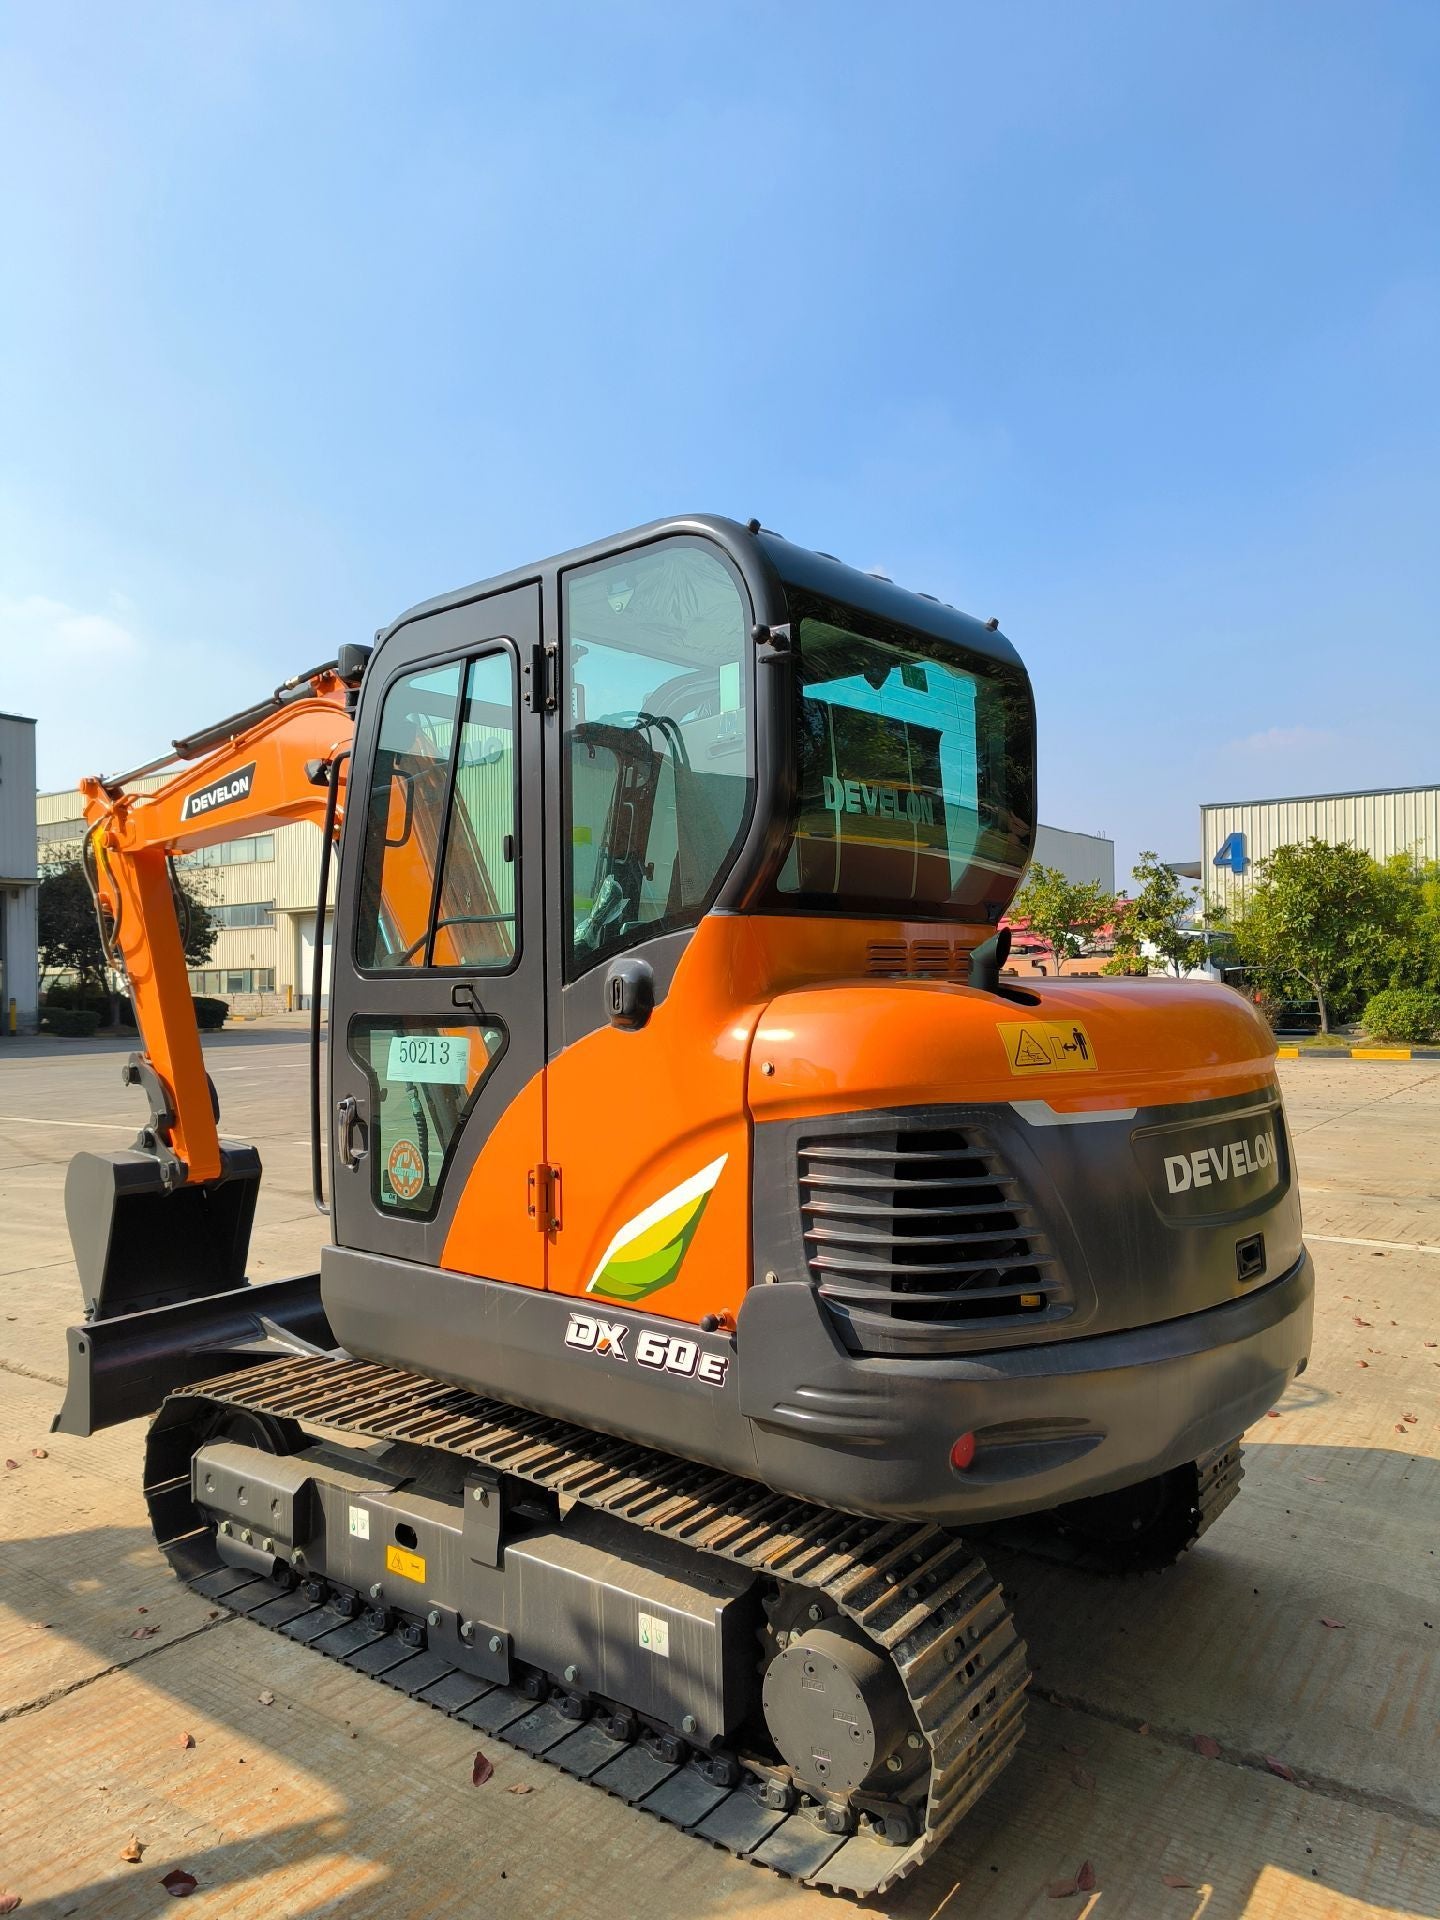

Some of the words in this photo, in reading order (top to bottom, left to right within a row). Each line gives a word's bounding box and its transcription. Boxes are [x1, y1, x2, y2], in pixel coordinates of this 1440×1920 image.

[192, 776, 249, 813] DEVELON
[823, 775, 934, 827] DEVELON
[1213, 832, 1250, 873] 4
[399, 1040, 450, 1064] 50213
[1164, 1131, 1277, 1194] DEVELON
[565, 1312, 629, 1361] DX
